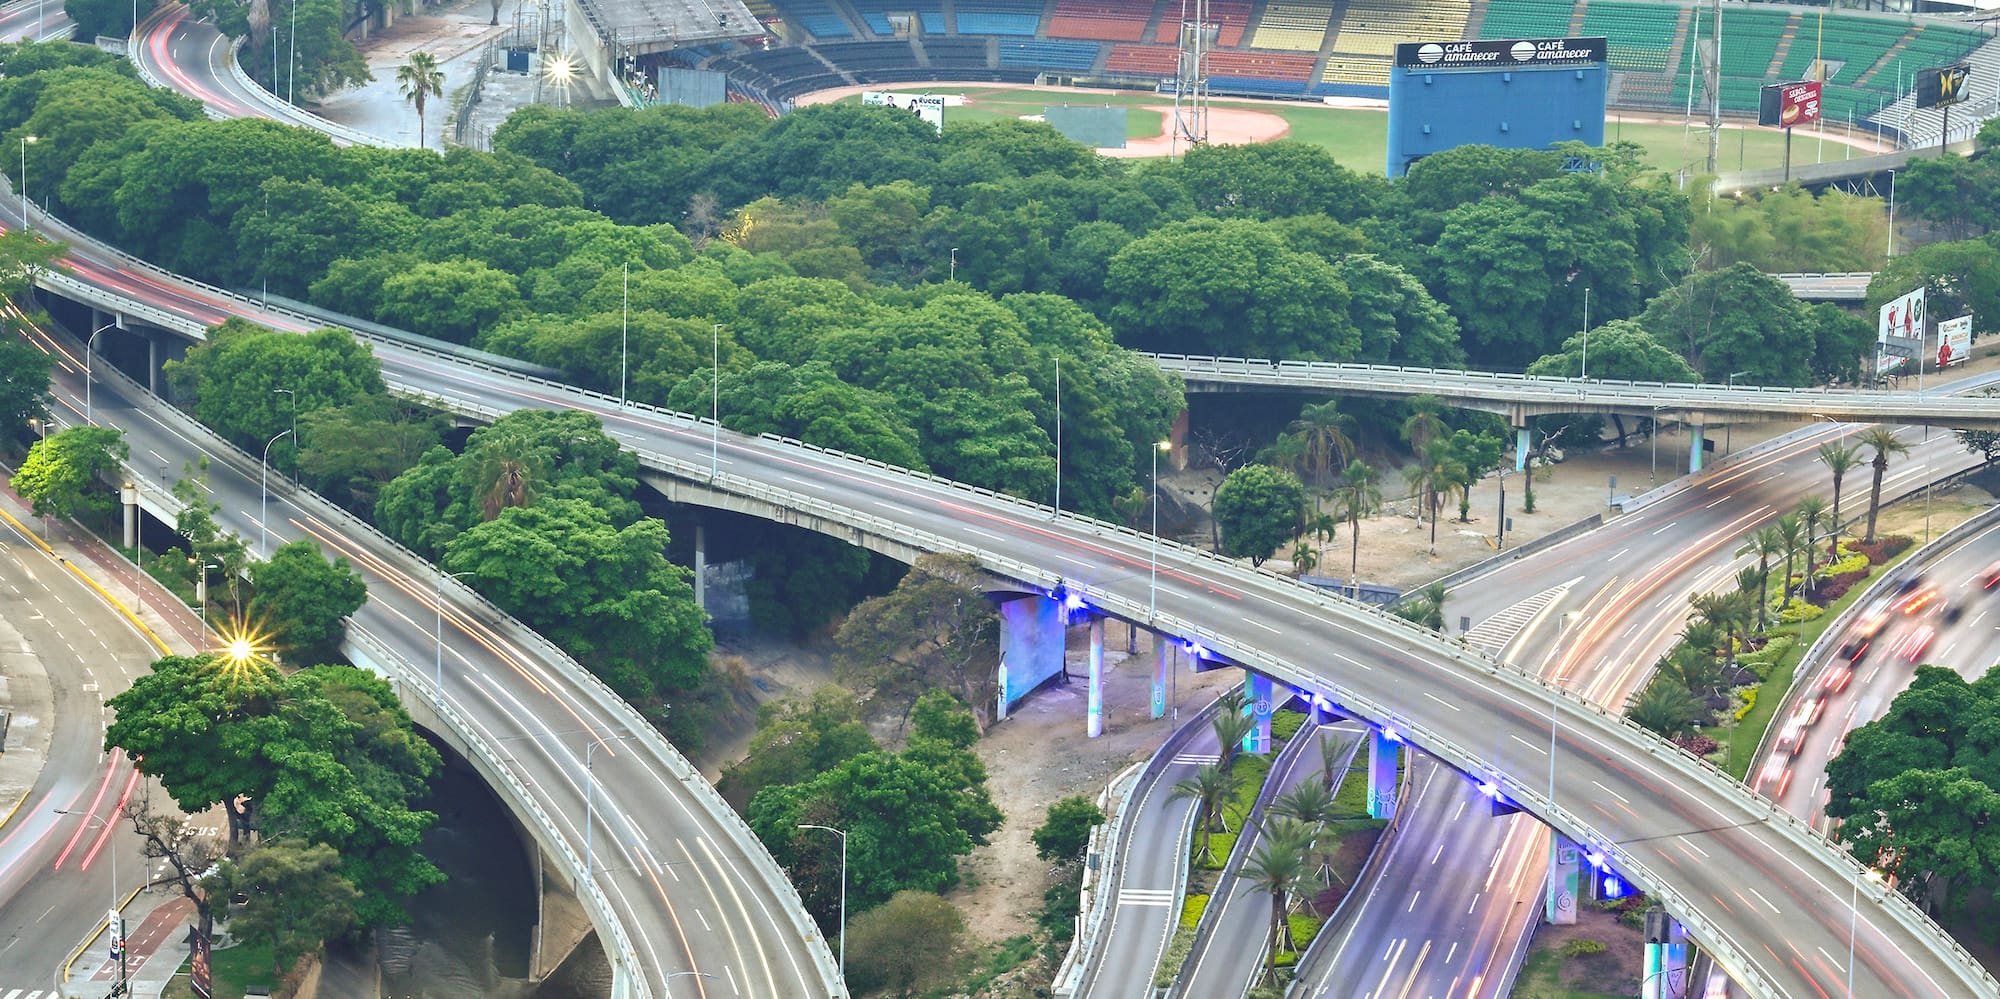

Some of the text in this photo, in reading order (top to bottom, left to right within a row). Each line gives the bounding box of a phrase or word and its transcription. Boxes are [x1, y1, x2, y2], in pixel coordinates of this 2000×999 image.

[1445, 41, 1472, 53] CAFÉ
[1537, 39, 1565, 51] CAFÉ
[1444, 51, 1500, 61] amanecer
[1537, 49, 1592, 60] amanecer
